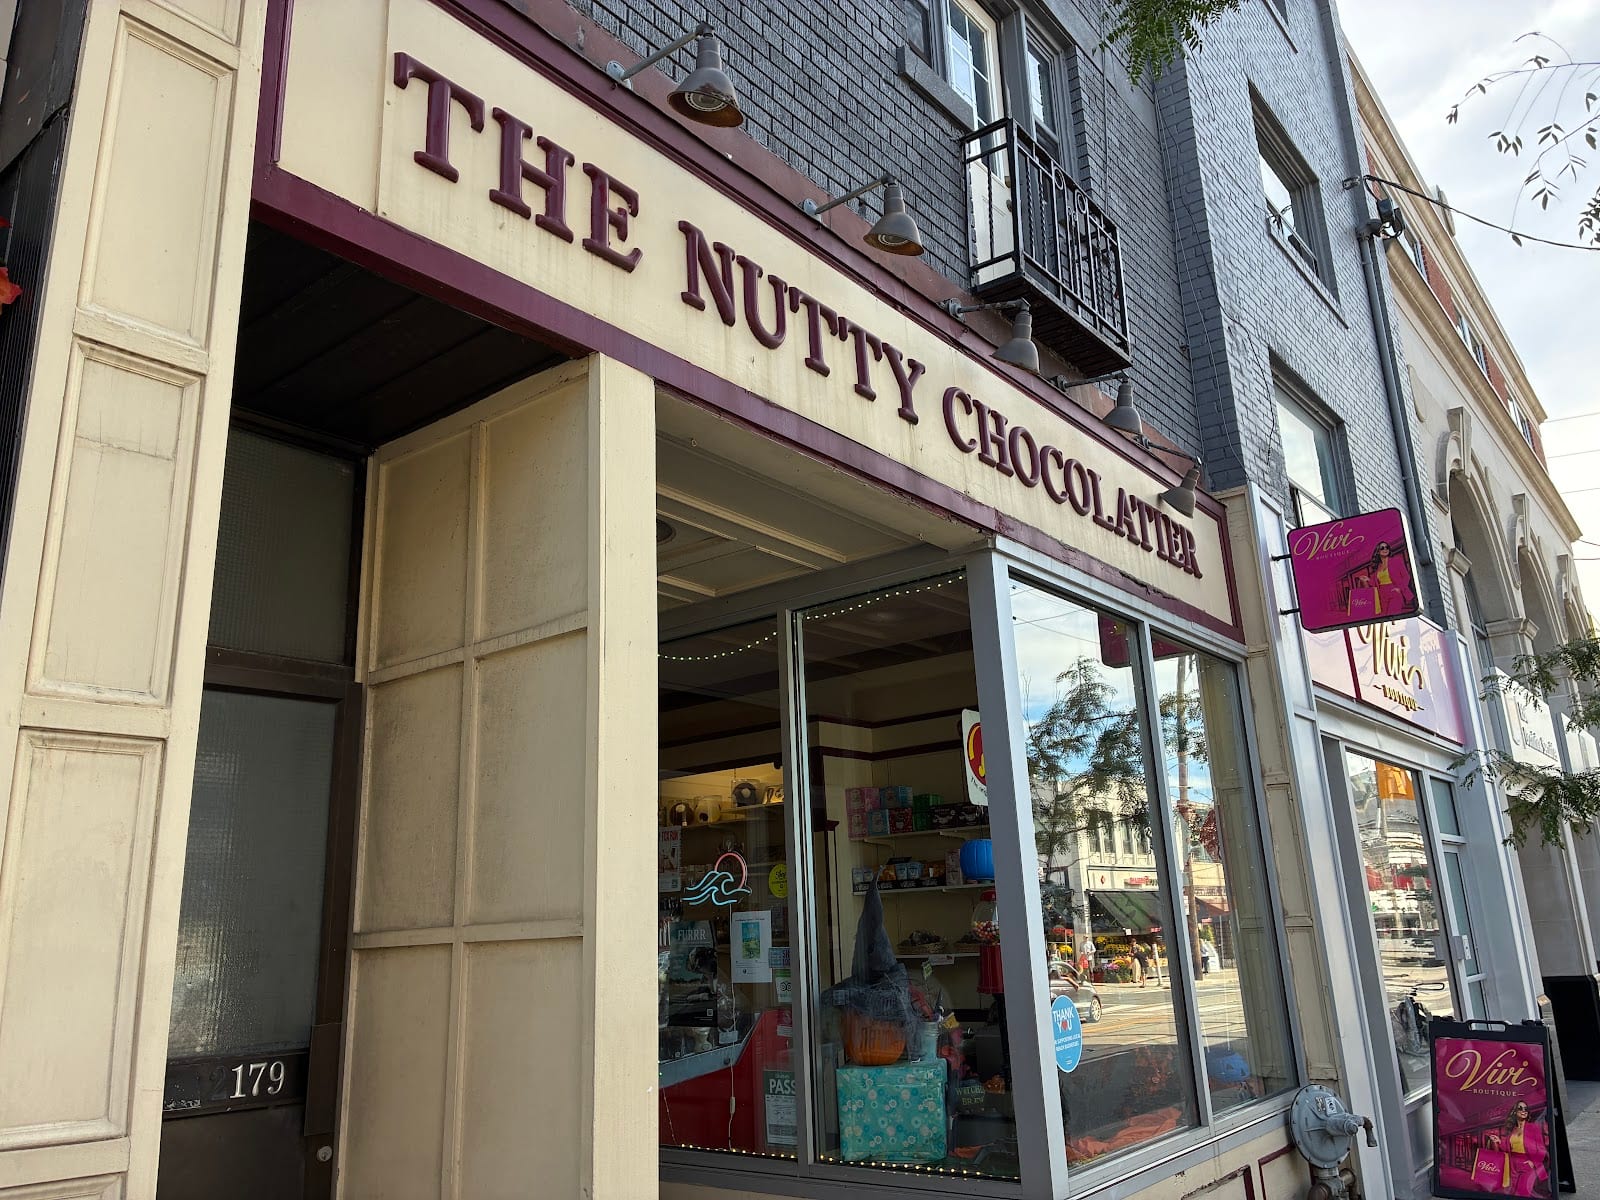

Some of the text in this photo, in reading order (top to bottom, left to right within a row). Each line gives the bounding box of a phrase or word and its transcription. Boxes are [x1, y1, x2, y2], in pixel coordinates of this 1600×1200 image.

[394, 51, 1203, 579] THE NUTTY CHOCOLATIER
[1294, 521, 1364, 561] Vivi
[1052, 1006, 1074, 1022] THANK
[1445, 1048, 1538, 1091] Vivi
[1473, 1088, 1517, 1097] BOUTIQUE
